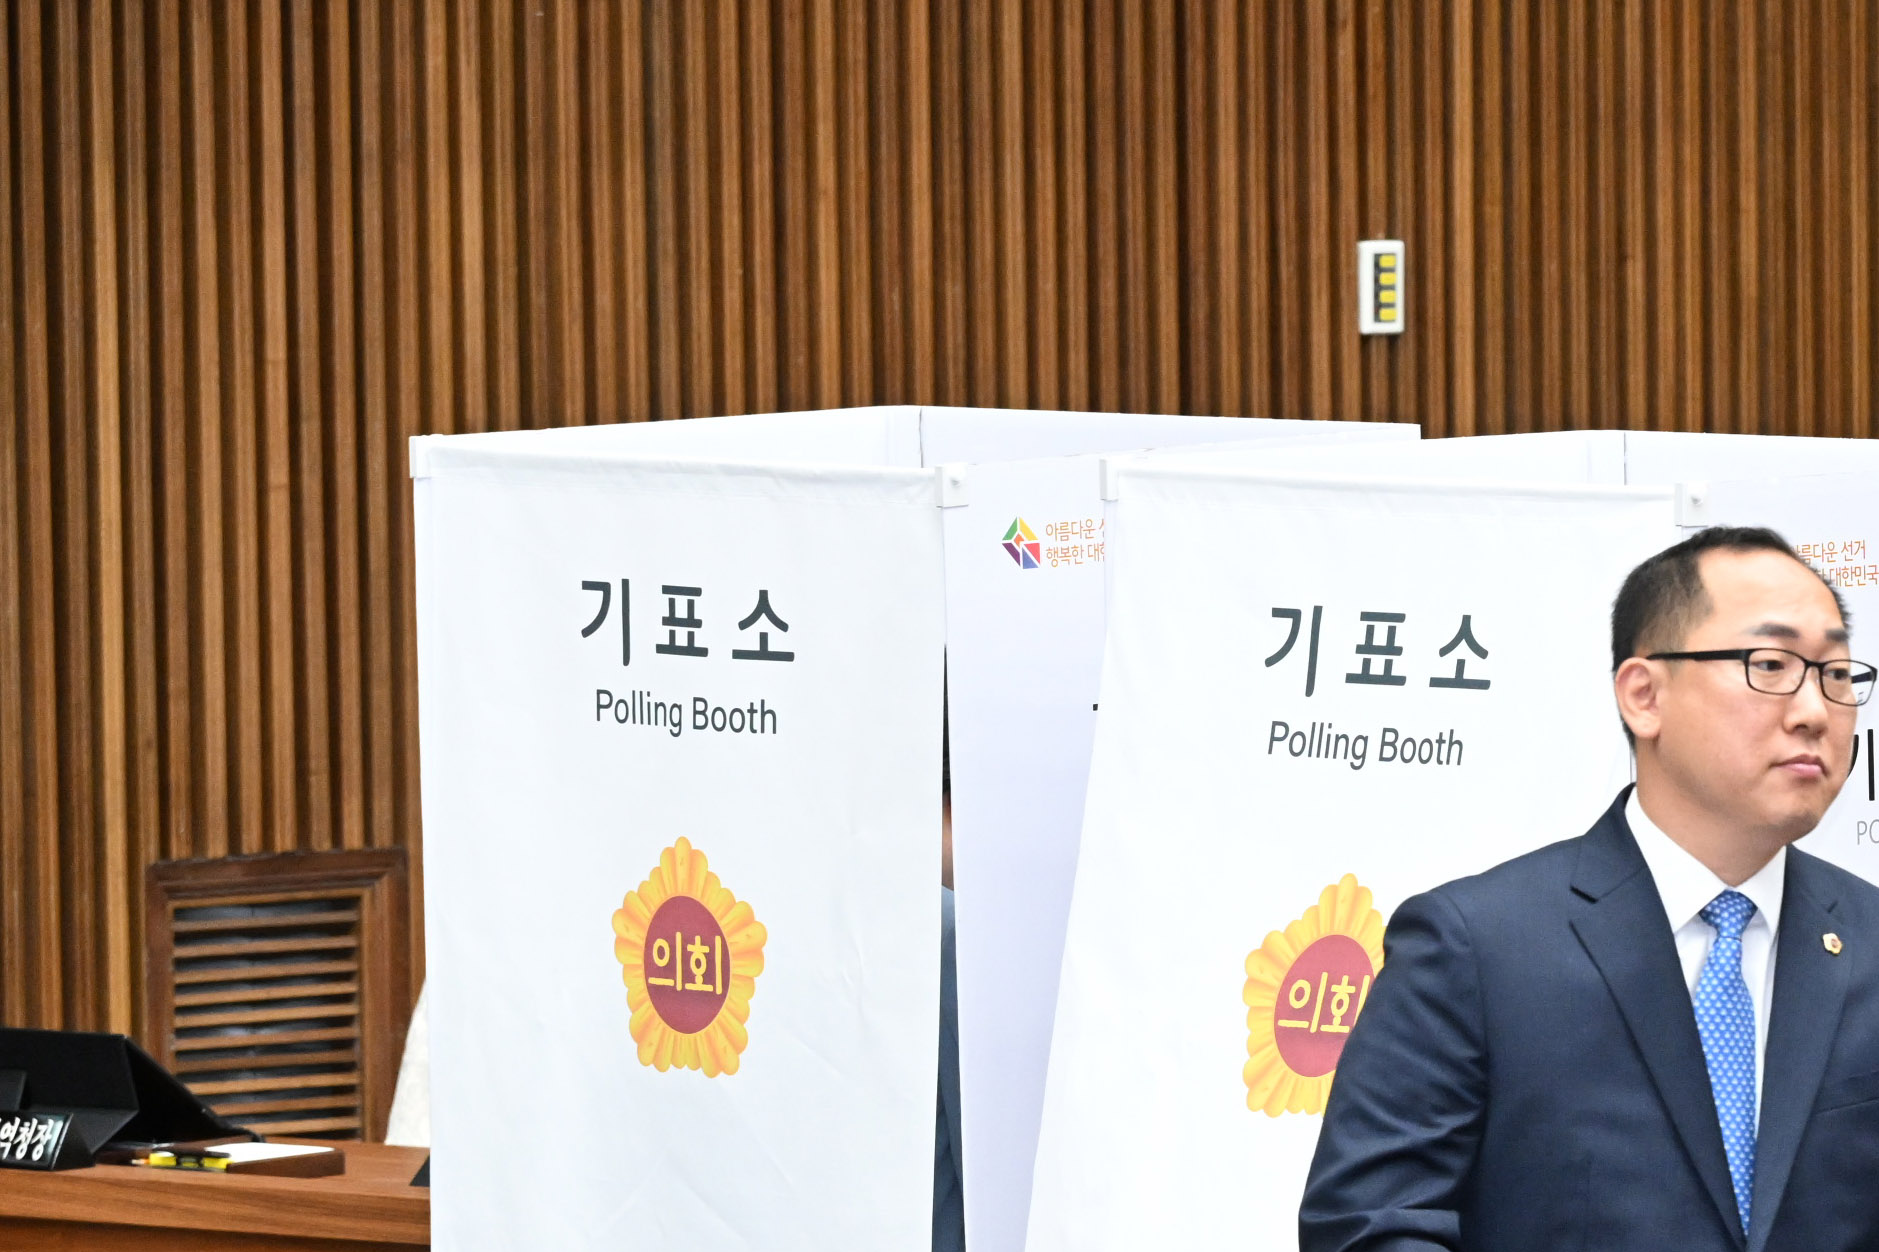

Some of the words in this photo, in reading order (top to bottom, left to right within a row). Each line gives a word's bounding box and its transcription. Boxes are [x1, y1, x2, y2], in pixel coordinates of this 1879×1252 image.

[1045, 518, 1096, 542] 아름다운
[1045, 544, 1084, 568] 행복한
[1841, 540, 1866, 562] 선거
[1829, 565, 1879, 587] 대한민국
[595, 688, 683, 739] Polling
[691, 696, 778, 736] Booth
[1267, 720, 1369, 771] Polling
[1378, 726, 1464, 767] Booth
[648, 932, 723, 995] 의회
[1277, 971, 1371, 1034] 의회
